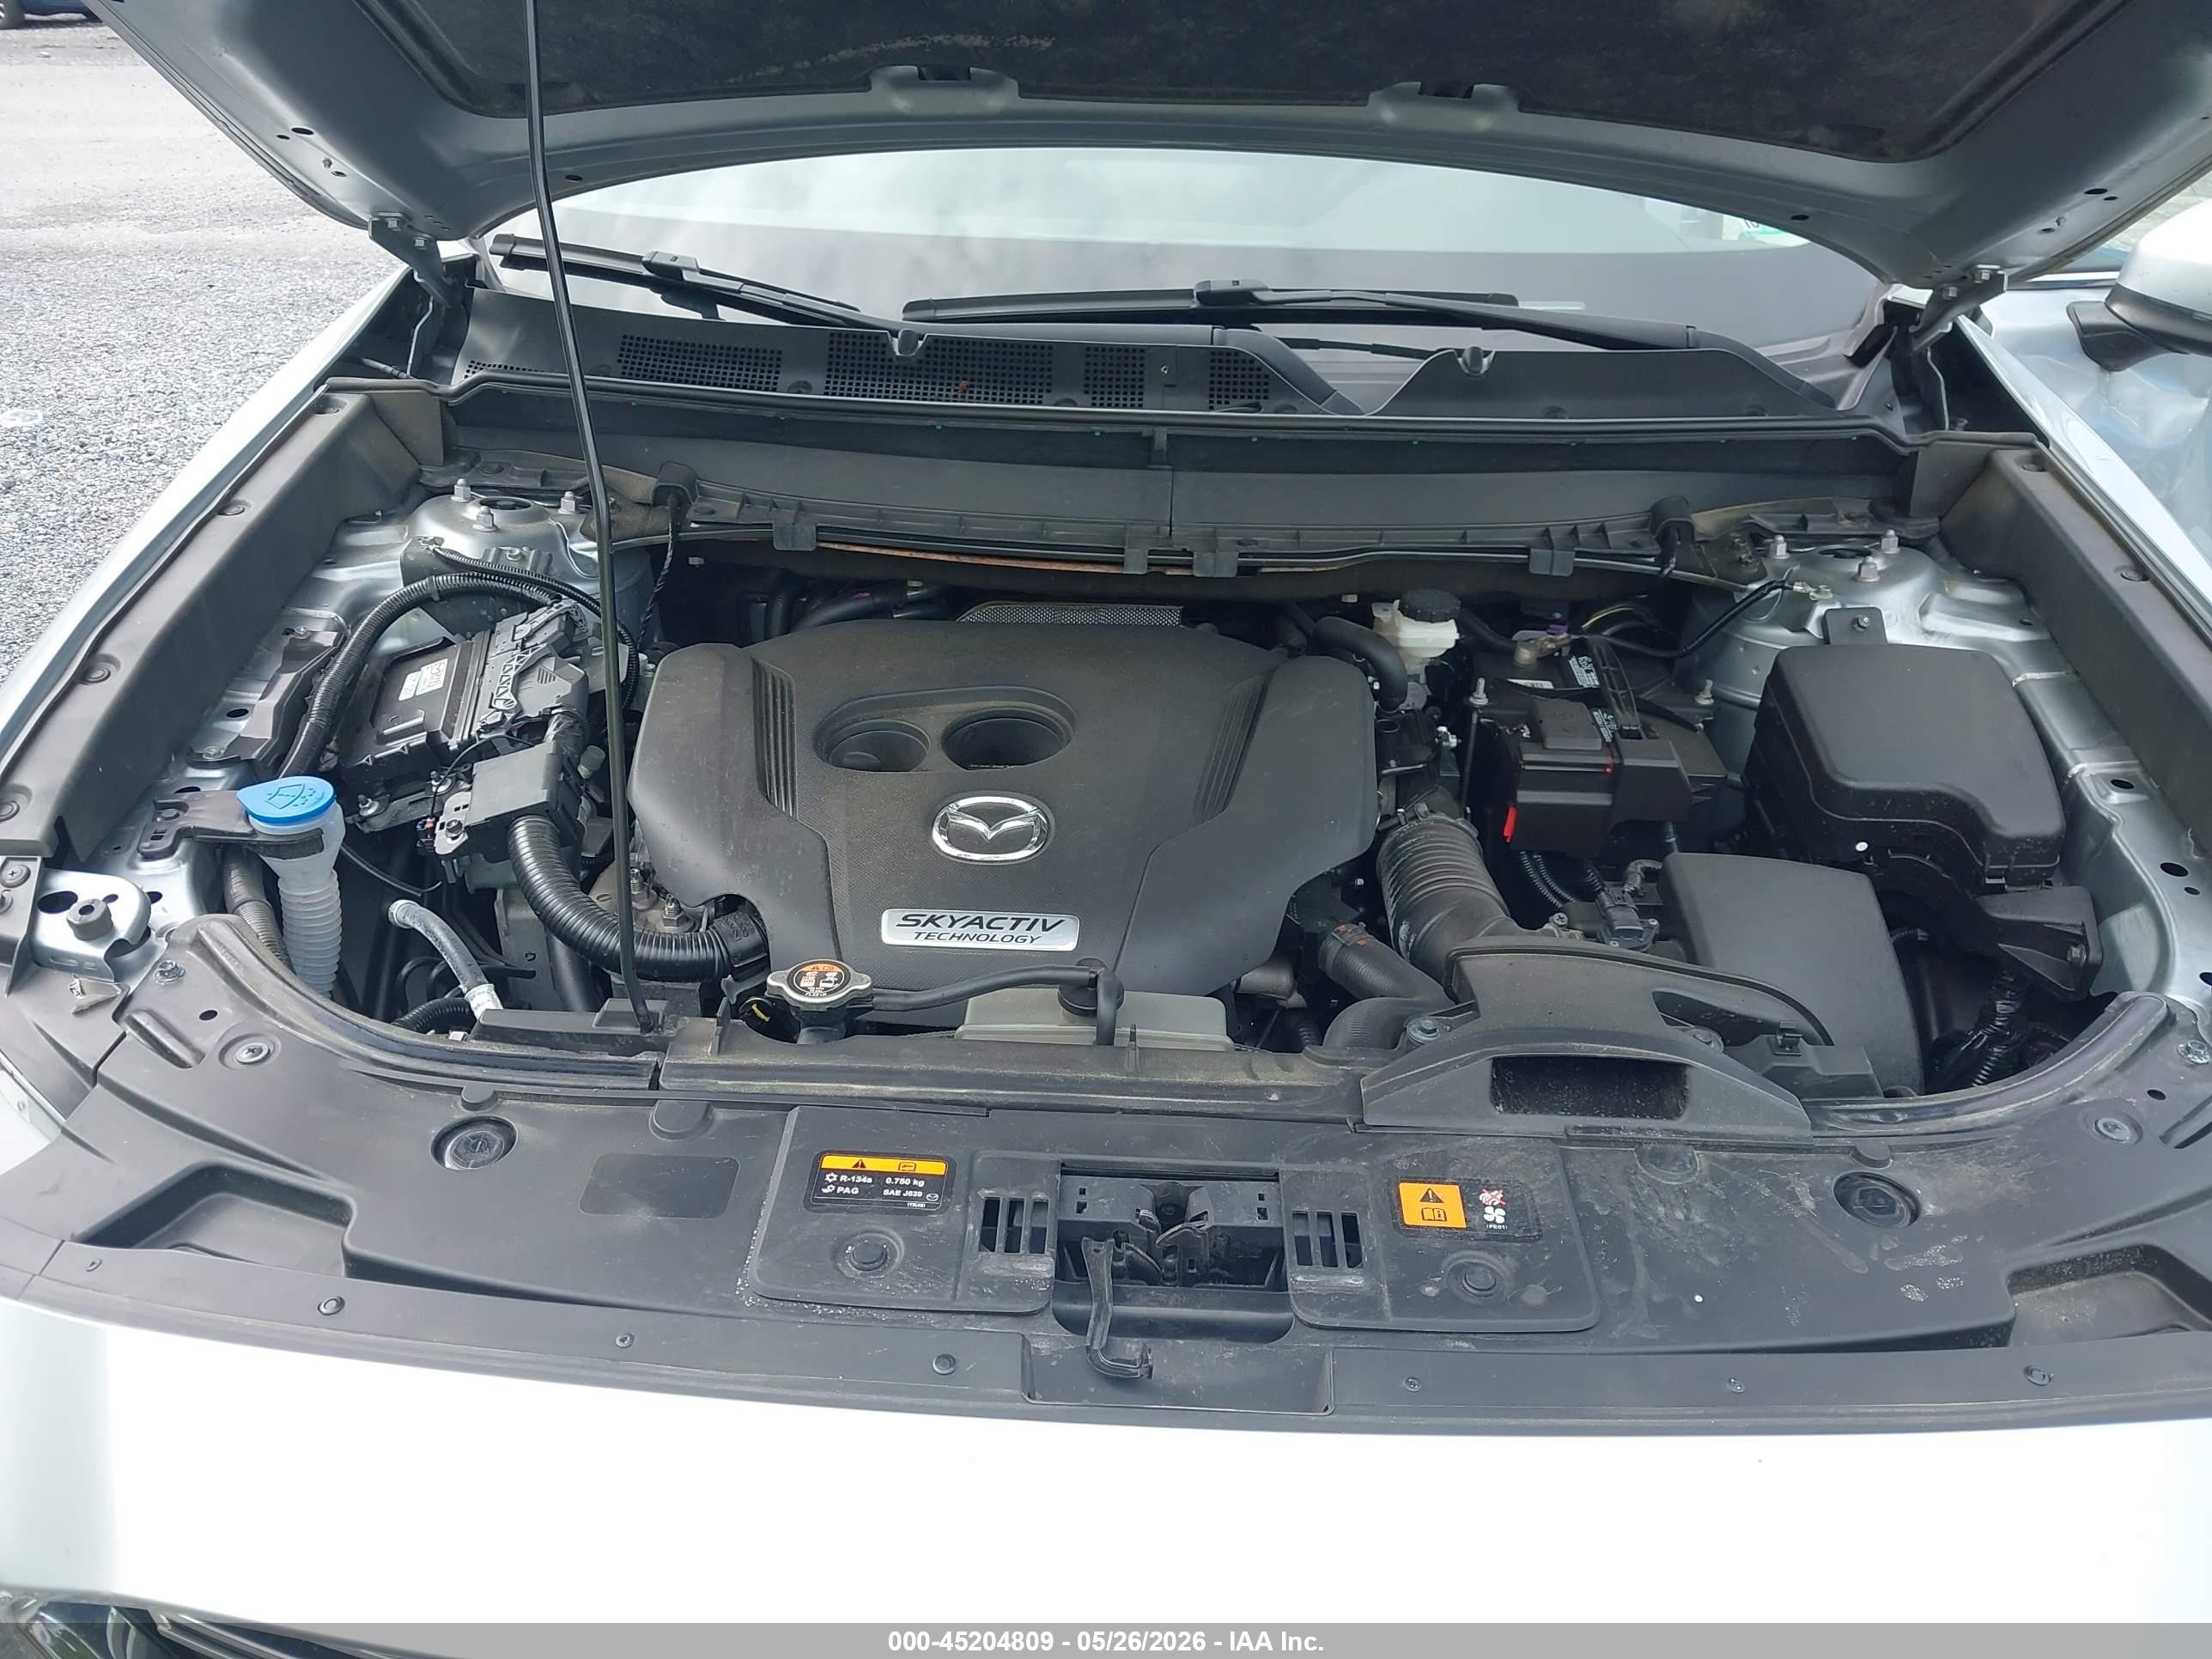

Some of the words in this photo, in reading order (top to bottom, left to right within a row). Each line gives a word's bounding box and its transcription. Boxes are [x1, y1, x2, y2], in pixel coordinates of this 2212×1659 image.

[896, 914, 1066, 933] SKYACTIV
[914, 931, 1042, 944] TECHNOLOGY
[840, 1175, 873, 1183] R-134a
[913, 1178, 925, 1187] kg
[836, 1186, 860, 1194] PAG
